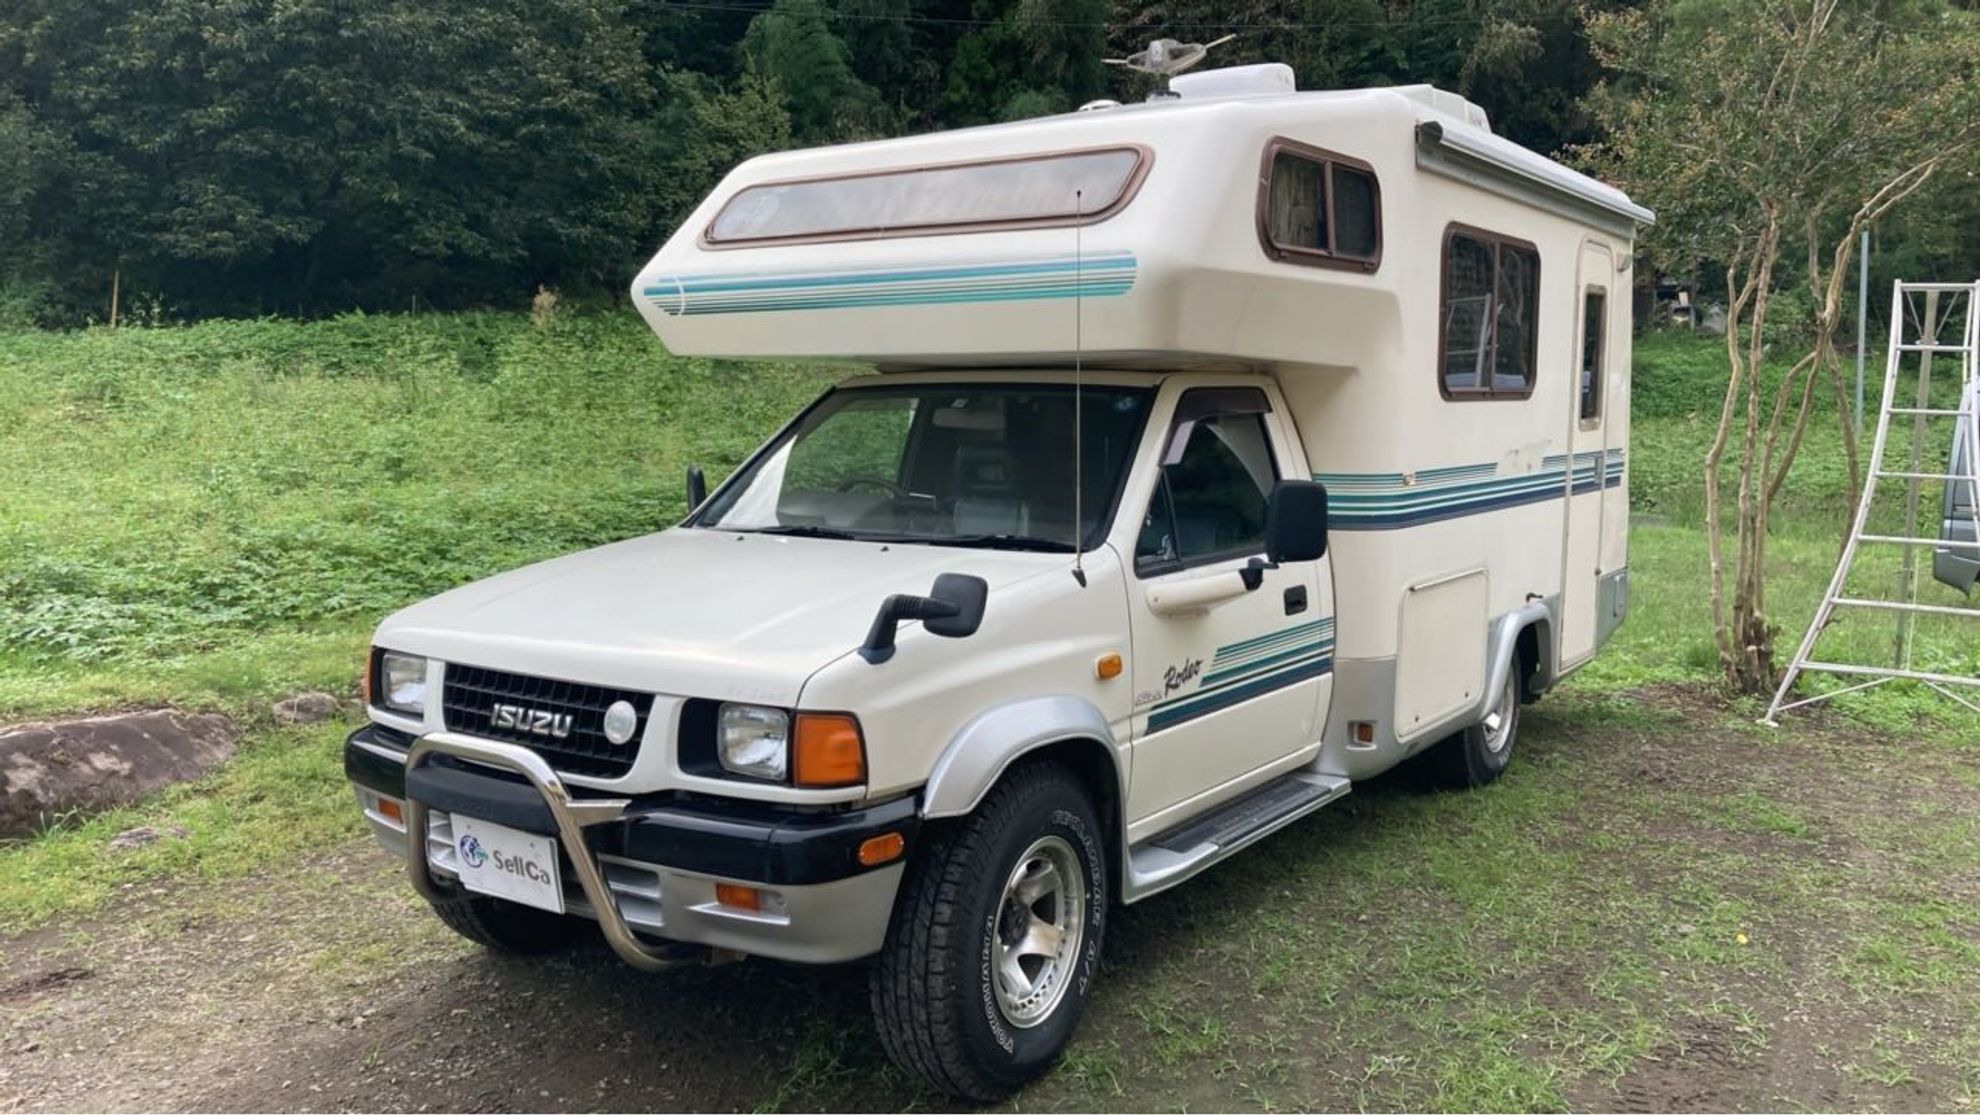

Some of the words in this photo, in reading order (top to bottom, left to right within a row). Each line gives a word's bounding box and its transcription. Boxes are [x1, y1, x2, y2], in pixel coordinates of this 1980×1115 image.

[1163, 657, 1203, 697] Rodeo
[490, 703, 573, 737] ISUZU
[493, 850, 551, 885] SellCa
